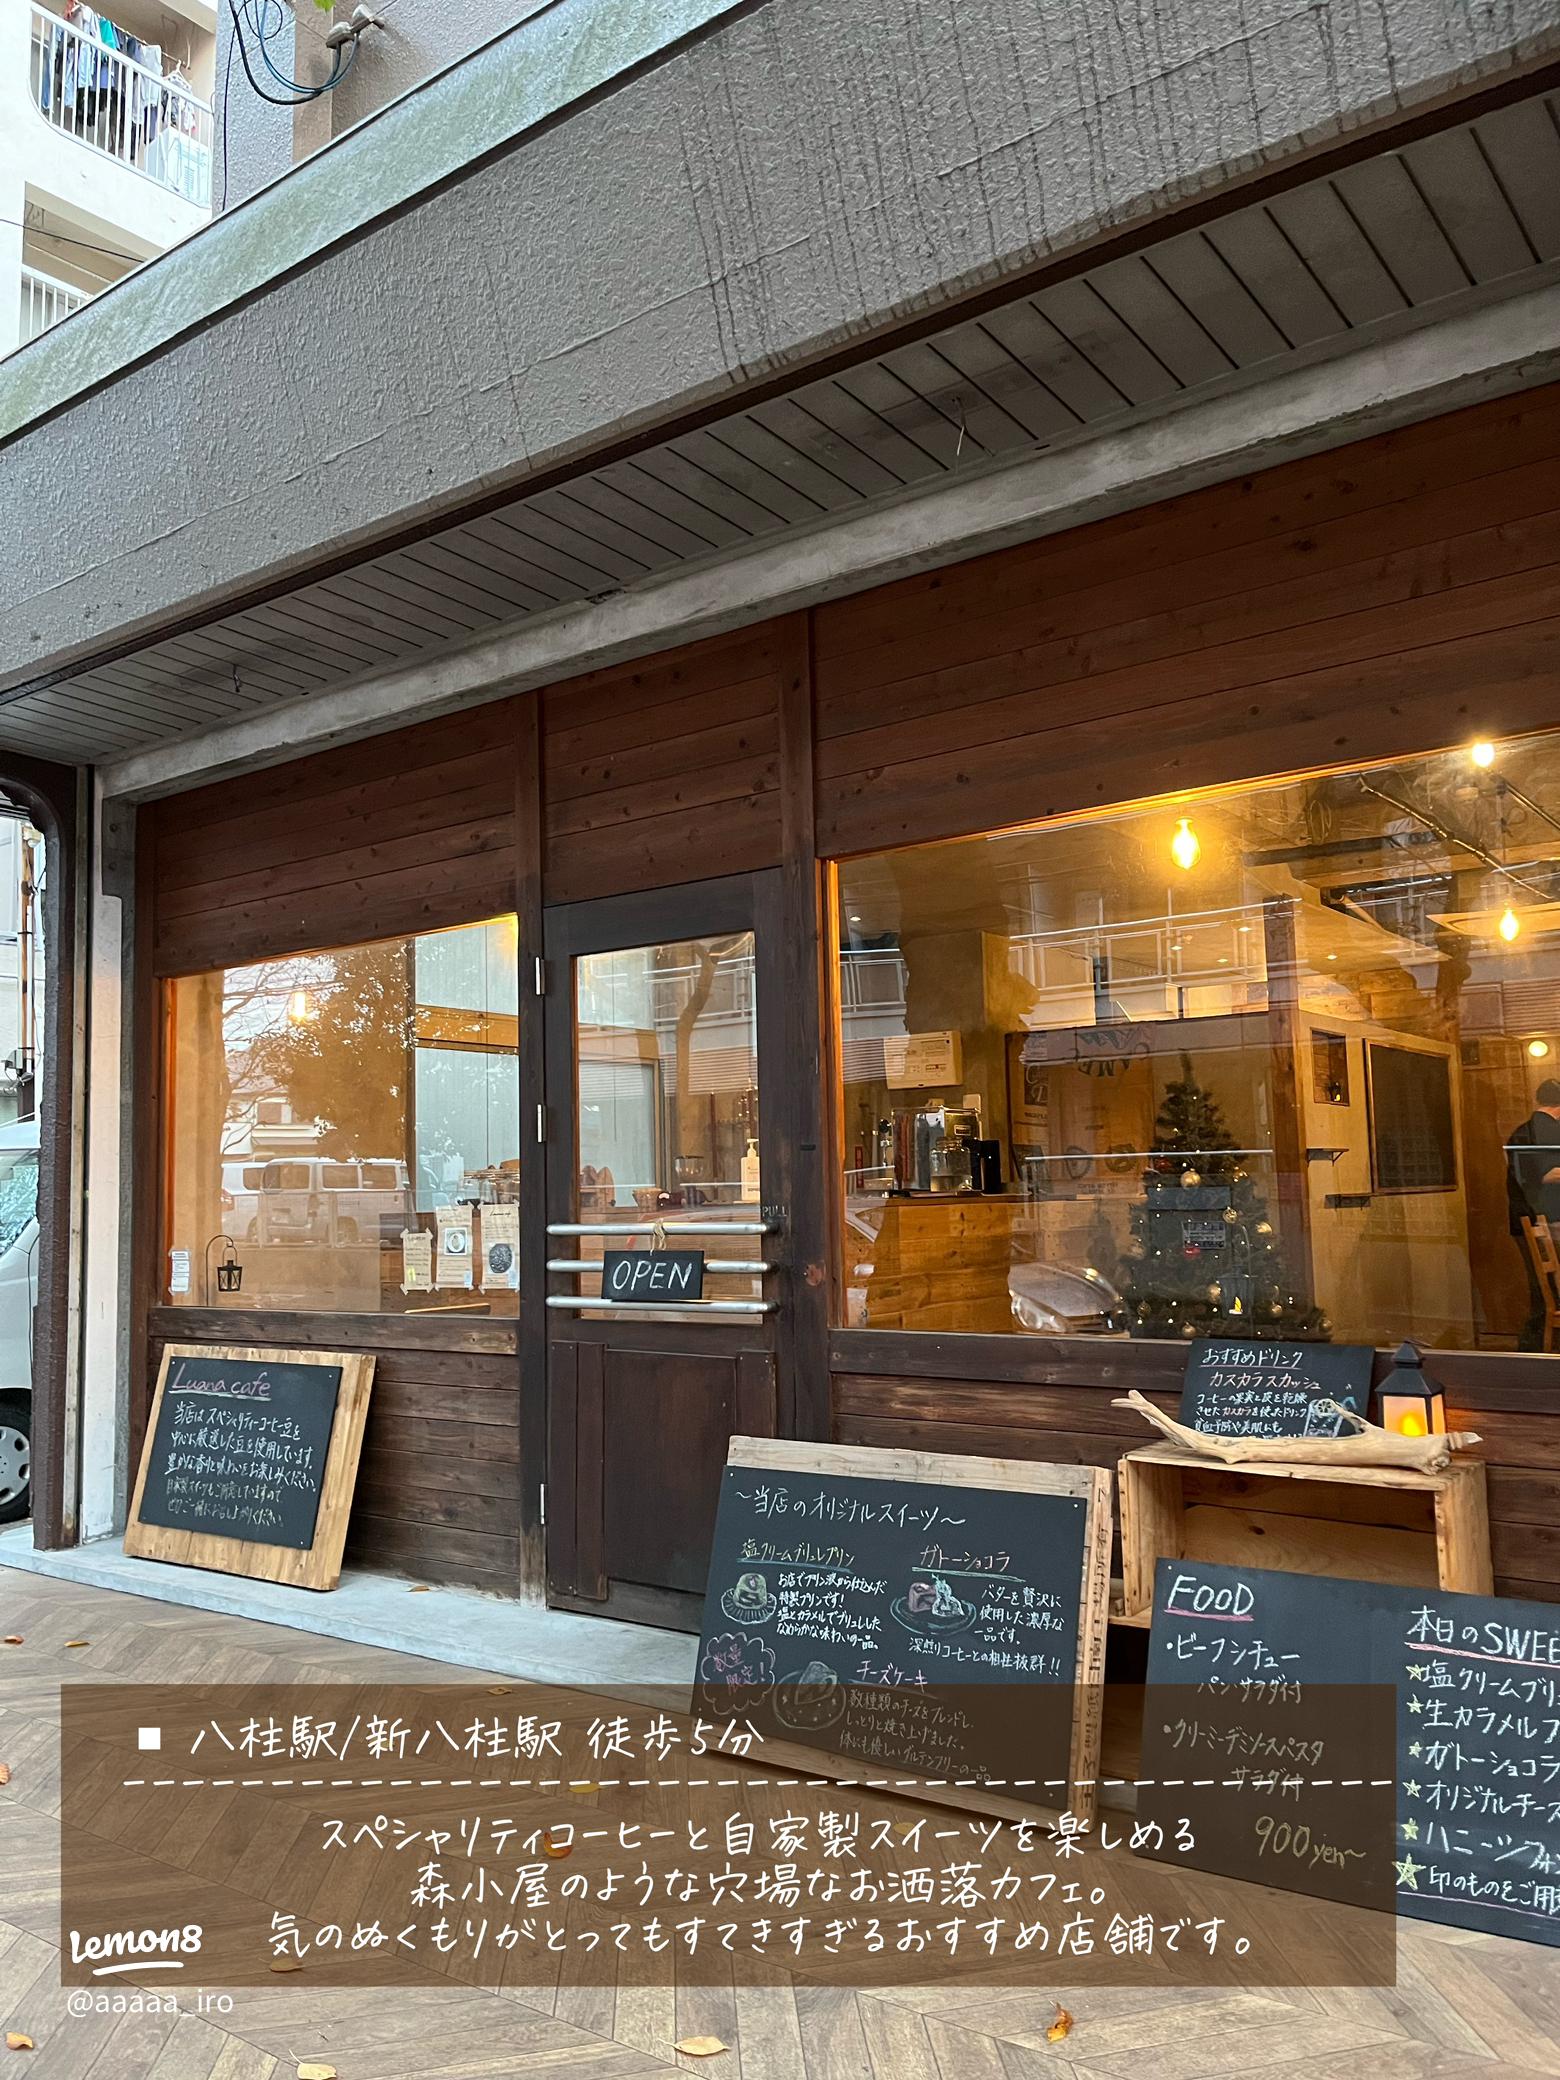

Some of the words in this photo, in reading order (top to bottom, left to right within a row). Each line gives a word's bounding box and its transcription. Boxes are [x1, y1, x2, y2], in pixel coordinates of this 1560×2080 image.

[762, 1204, 788, 1218] PULL
[612, 1259, 693, 1292] OPEN
[1202, 1347, 1303, 1368] おすすめドリンク
[172, 1363, 226, 1392] Luana
[230, 1371, 271, 1397] cafe
[1209, 1371, 1321, 1390] カスカラスカッシュ
[920, 1544, 1010, 1572] ガトーショコラ
[1168, 1574, 1254, 1615] FOOD
[980, 1604, 1065, 1632] 使用した濃厚な
[856, 1660, 928, 1694] チーズケーキ
[1421, 1659, 1560, 1708] 塩クリームブリ
[1428, 1865, 1560, 1916] 印のものをご用
